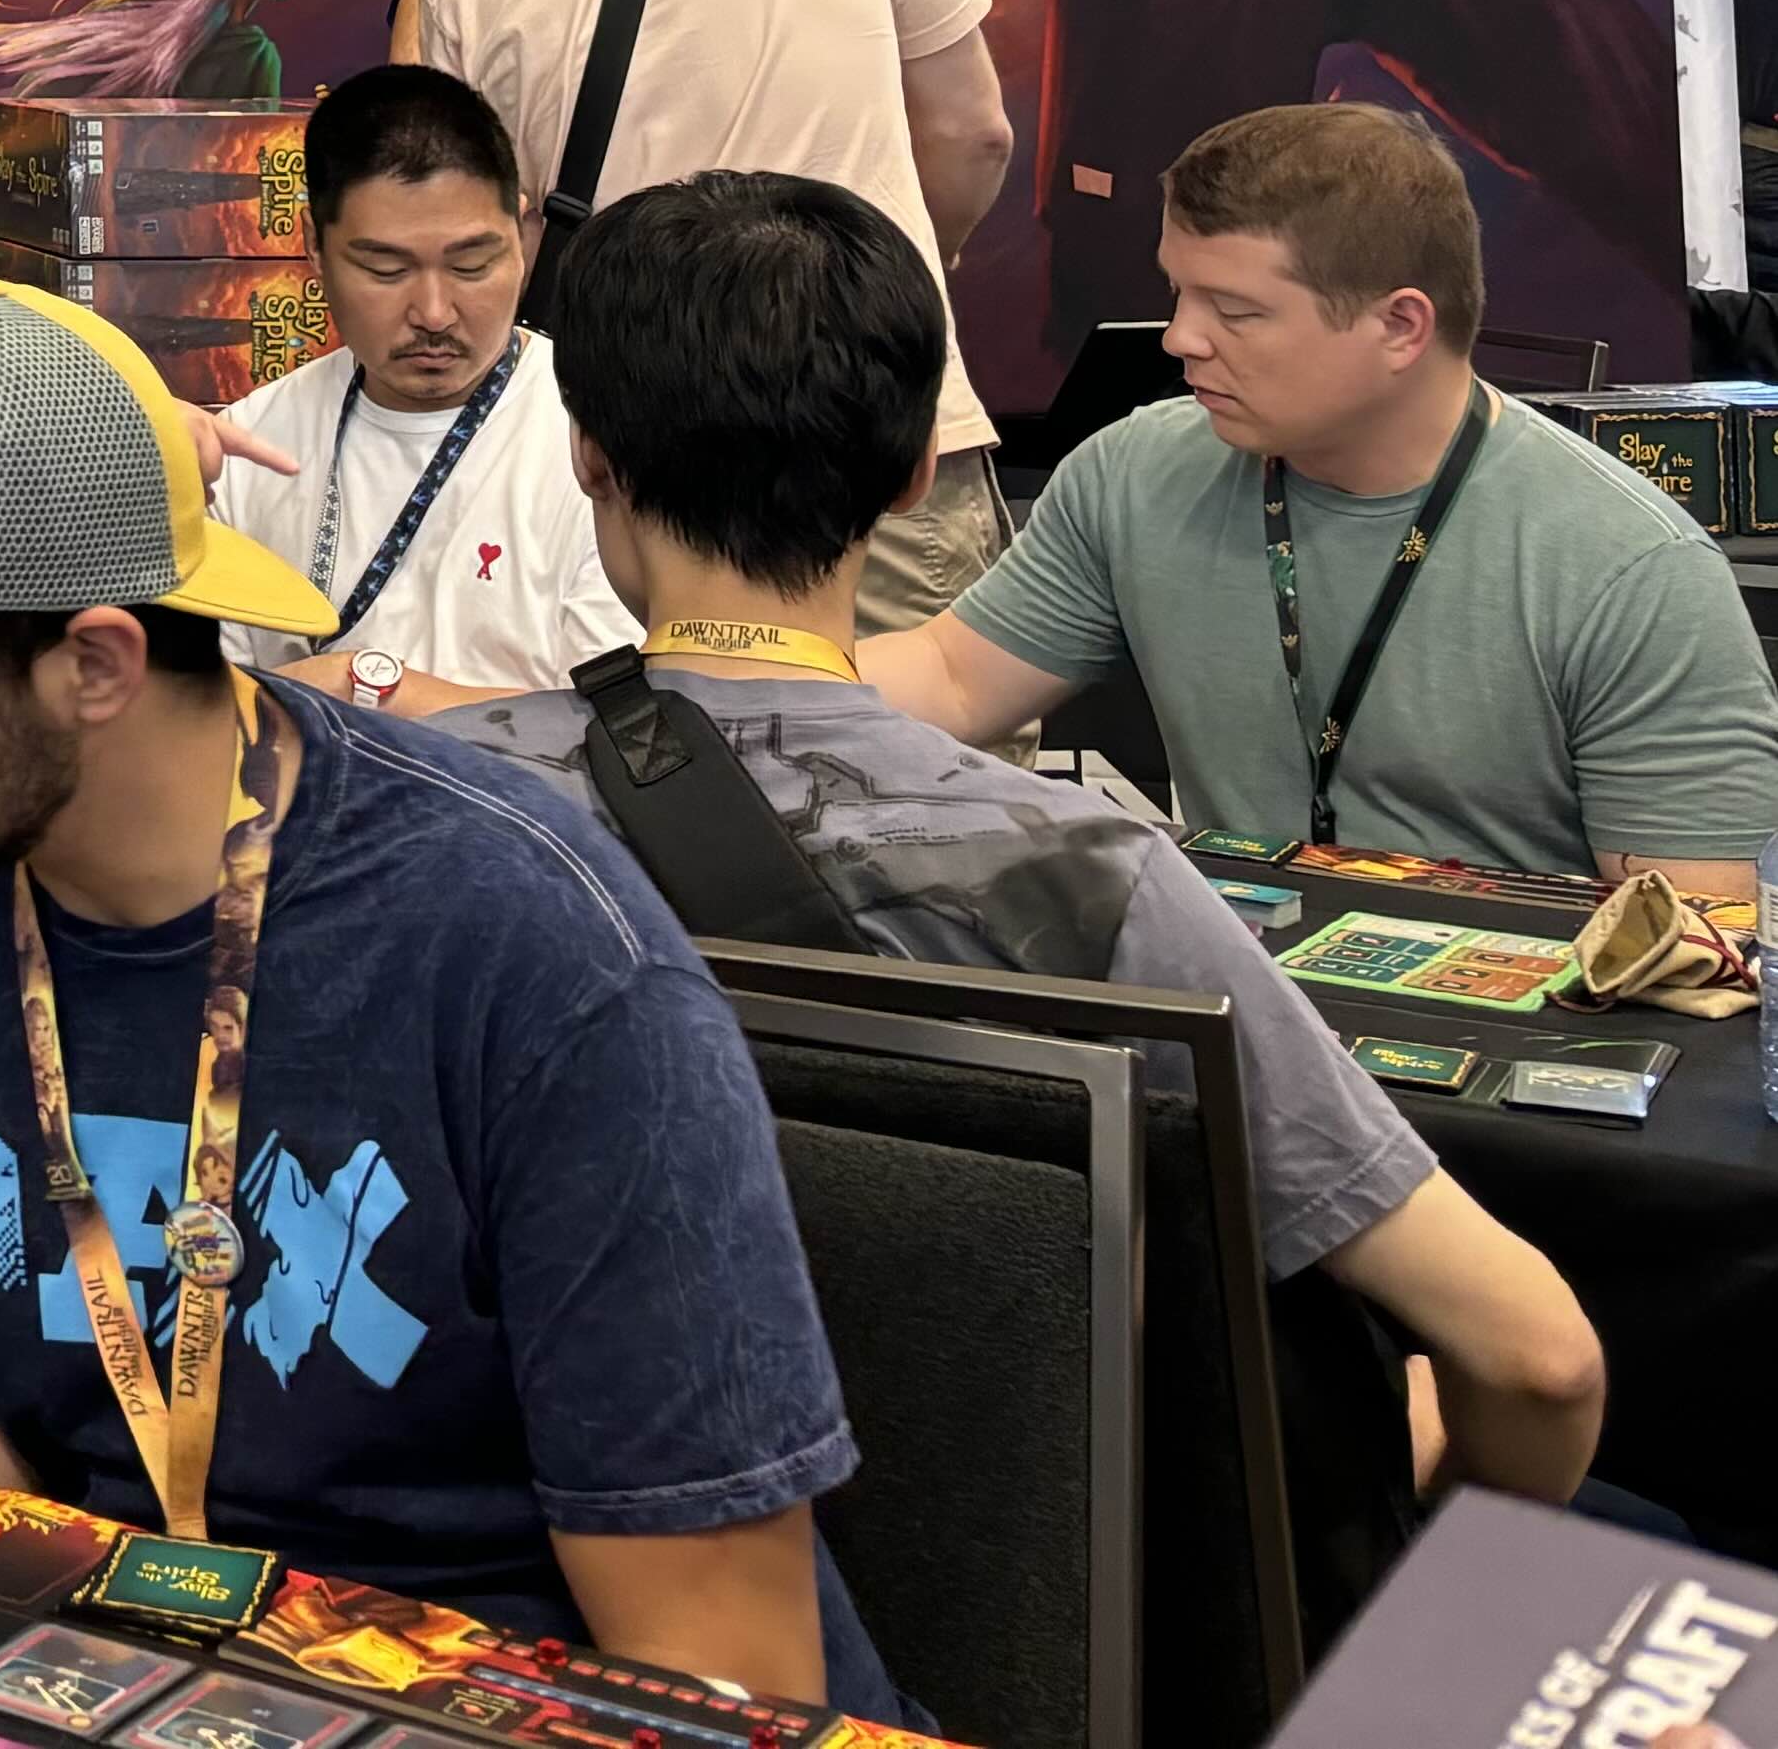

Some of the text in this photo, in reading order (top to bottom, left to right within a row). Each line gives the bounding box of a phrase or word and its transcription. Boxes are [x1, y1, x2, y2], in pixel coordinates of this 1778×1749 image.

[260, 150, 306, 237] Spire
[252, 295, 300, 381] Spire
[1619, 432, 1693, 469] Slay the
[670, 621, 790, 646] DAWNTRAIL
[83, 1266, 149, 1417] DAWNTRAIL
[177, 1286, 207, 1400] DAWNTR
[1581, 1578, 1778, 1749] RAFT
